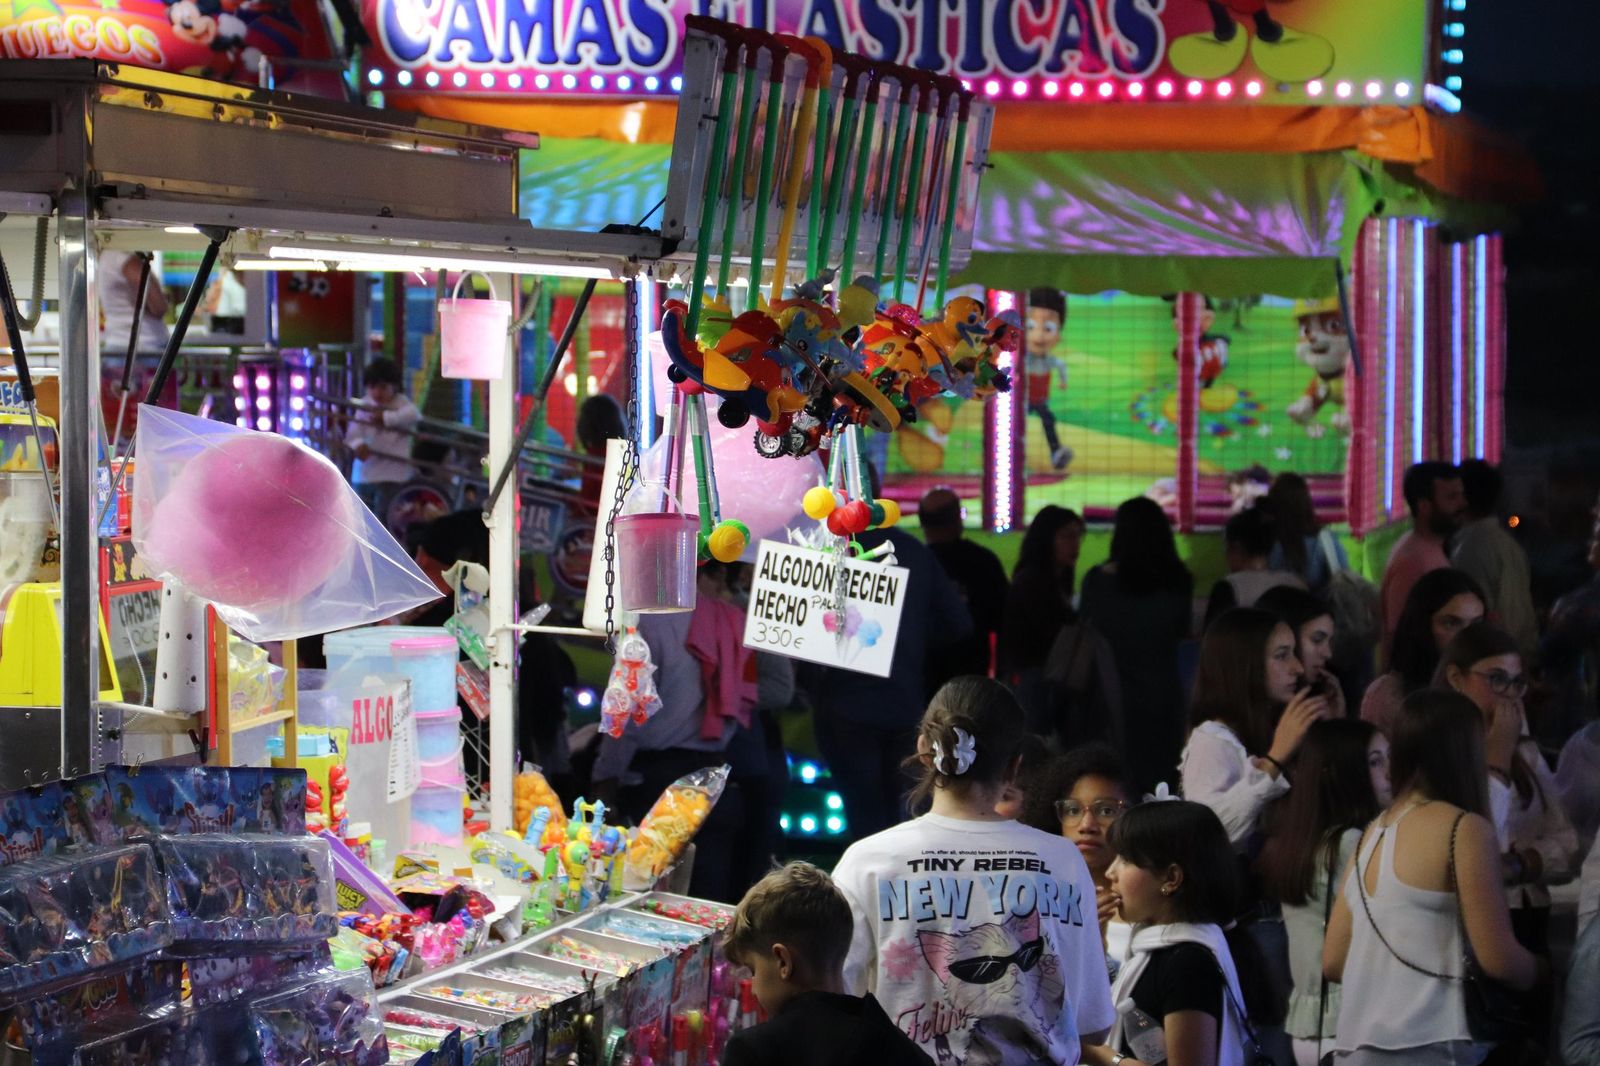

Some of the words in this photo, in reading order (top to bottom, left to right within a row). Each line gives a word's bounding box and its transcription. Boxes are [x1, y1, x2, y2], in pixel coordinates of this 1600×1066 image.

[0, 15, 163, 65] UEGOS
[379, 0, 677, 70] CAMAS
[759, 551, 836, 594] ALGODÓN
[754, 588, 808, 627] HECHO
[907, 858, 966, 873] TINY
[973, 858, 1052, 875] REBEL
[878, 876, 974, 923] NEW
[978, 874, 1083, 927] YORK
